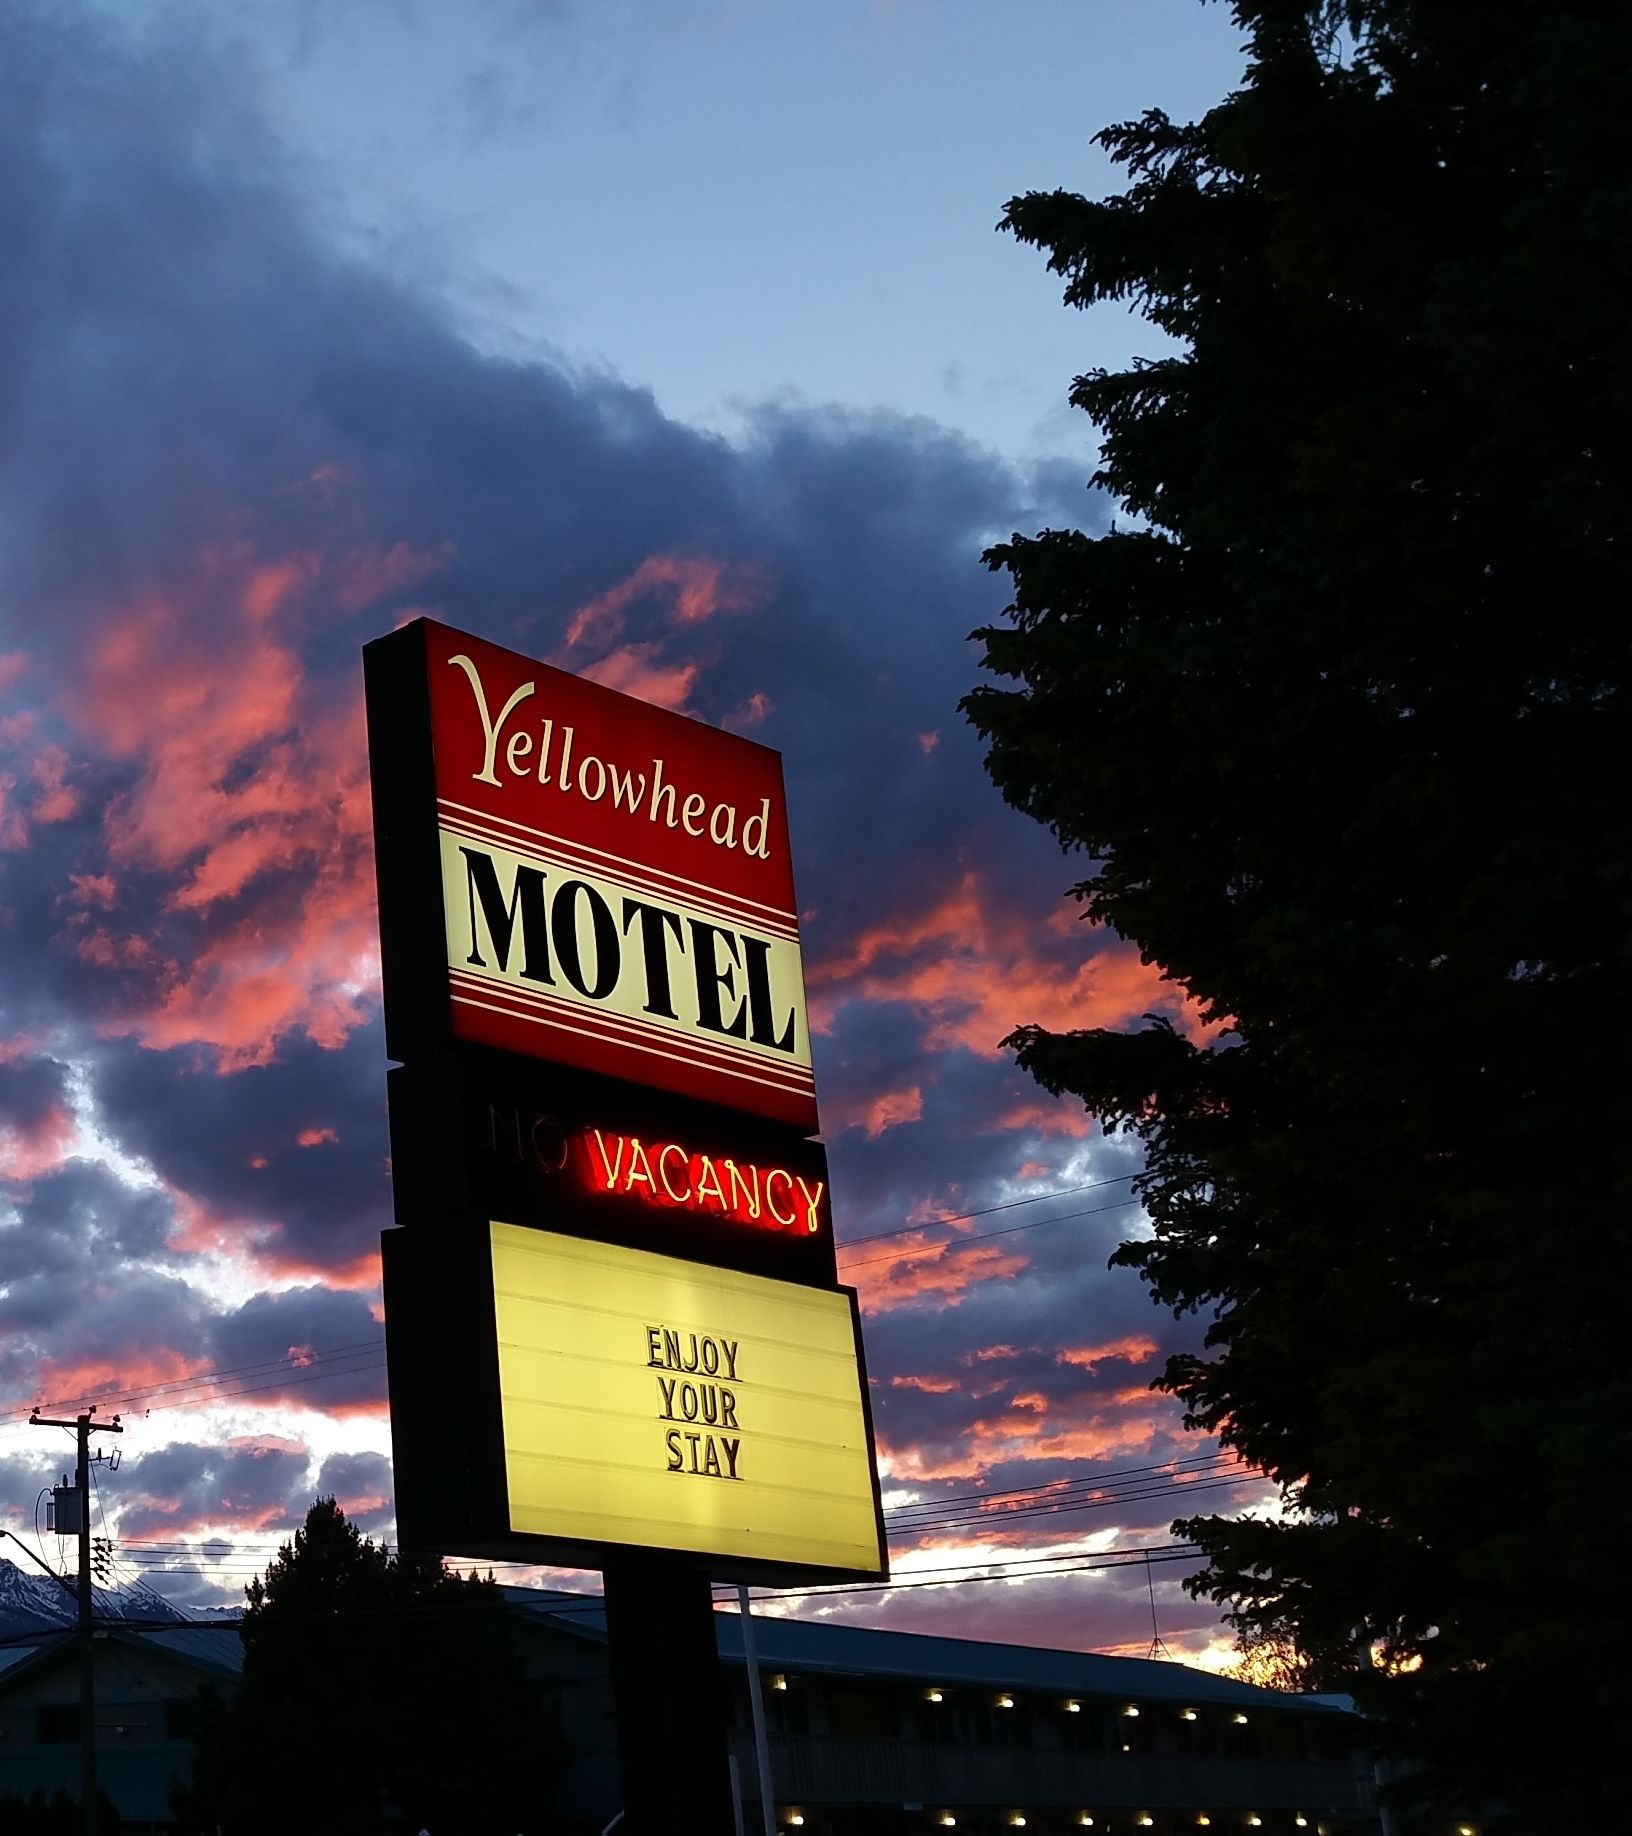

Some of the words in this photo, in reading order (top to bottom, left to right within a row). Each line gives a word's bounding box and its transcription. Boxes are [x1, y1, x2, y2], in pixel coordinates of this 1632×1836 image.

[448, 654, 771, 860] Yellowhead
[459, 846, 796, 1055] MOTEL
[487, 1104, 568, 1174] NO
[593, 1128, 824, 1233] VACANCY
[647, 1326, 739, 1379] ENJOY
[659, 1376, 738, 1429] YOUR
[667, 1430, 742, 1479] STAY
